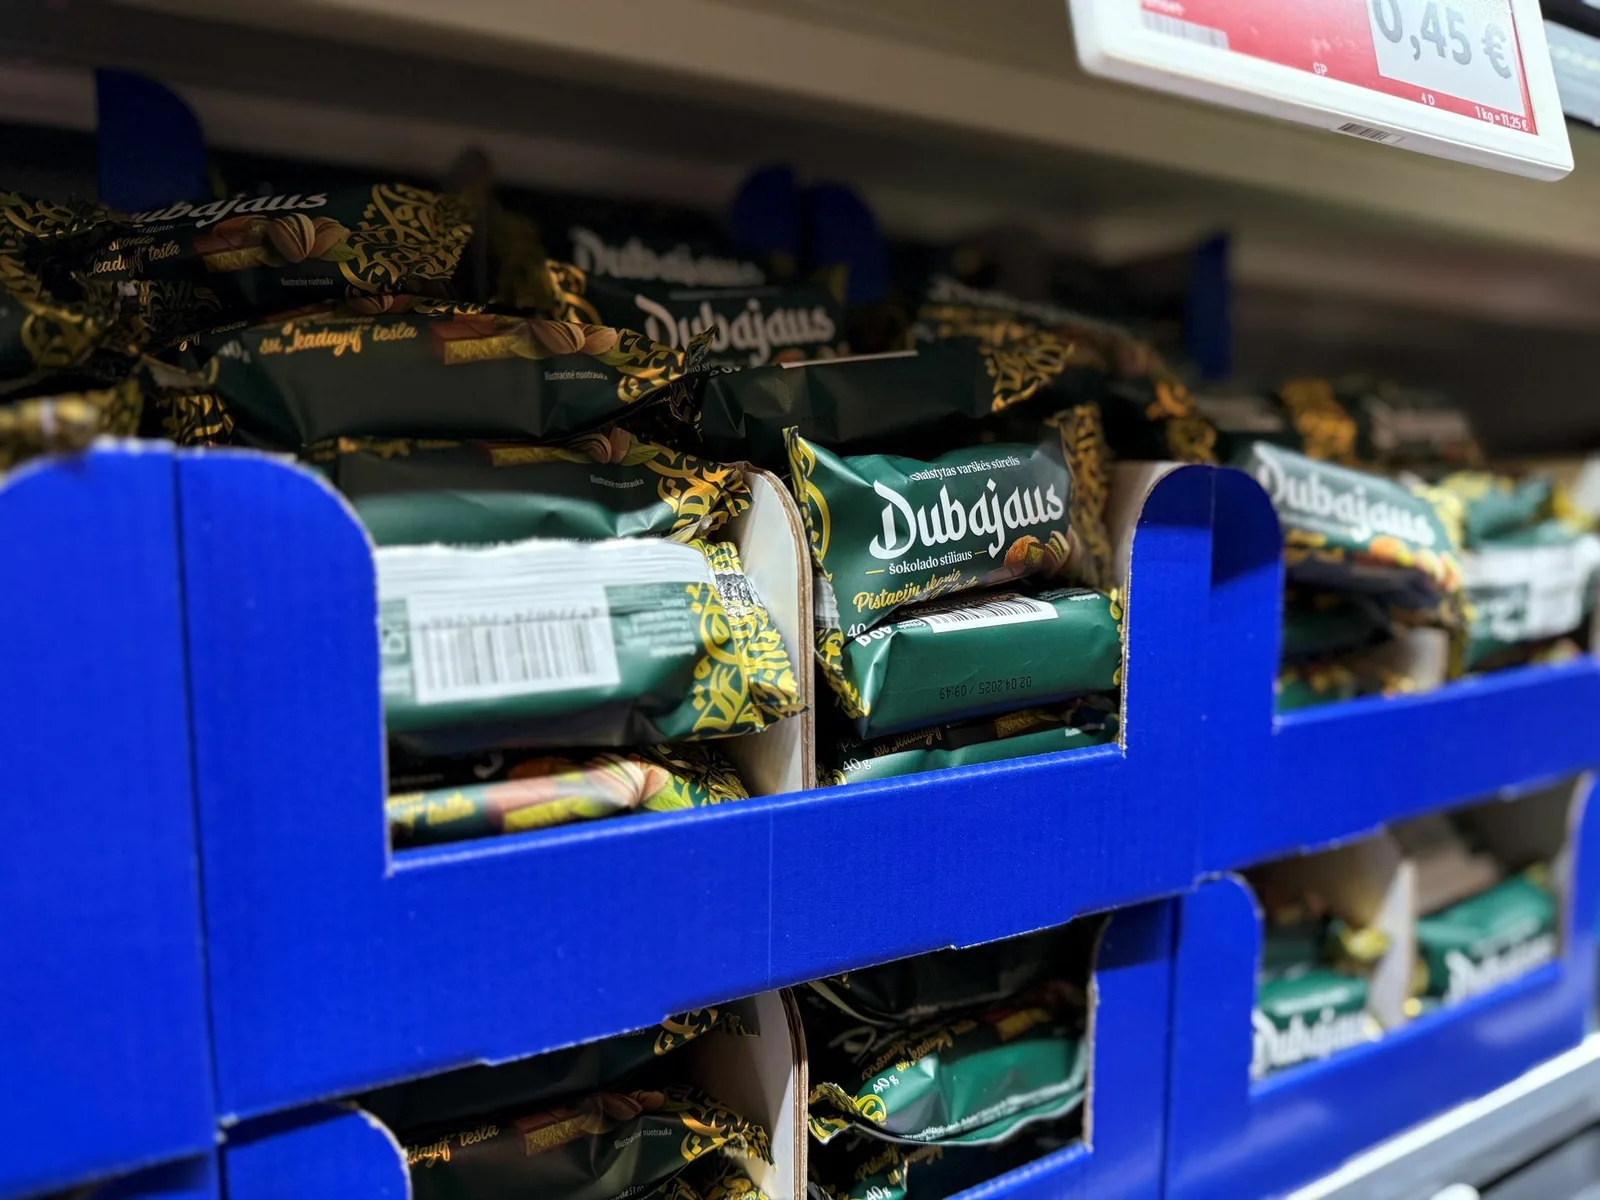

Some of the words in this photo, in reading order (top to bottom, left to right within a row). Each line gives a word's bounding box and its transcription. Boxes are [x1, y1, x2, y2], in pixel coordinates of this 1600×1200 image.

[1373, 0, 1472, 66] 0,45
[1313, 62, 1328, 76] GP
[1481, 109, 1493, 125] kg
[1501, 112, 1521, 130] 11,25
[129, 192, 329, 229] ubajaus
[372, 321, 418, 341] tešla
[957, 460, 992, 475] varškės
[992, 455, 1021, 469] sūrelis
[868, 478, 1064, 560] Dubajaus
[889, 558, 939, 575] šokolado
[940, 550, 973, 567] stiliaus
[940, 684, 967, 699] 09:49
[978, 675, 1032, 695] 02.04.2025
[842, 757, 861, 773] 40
[872, 1076, 890, 1094] 40
[458, 1123, 500, 1147] tešla
